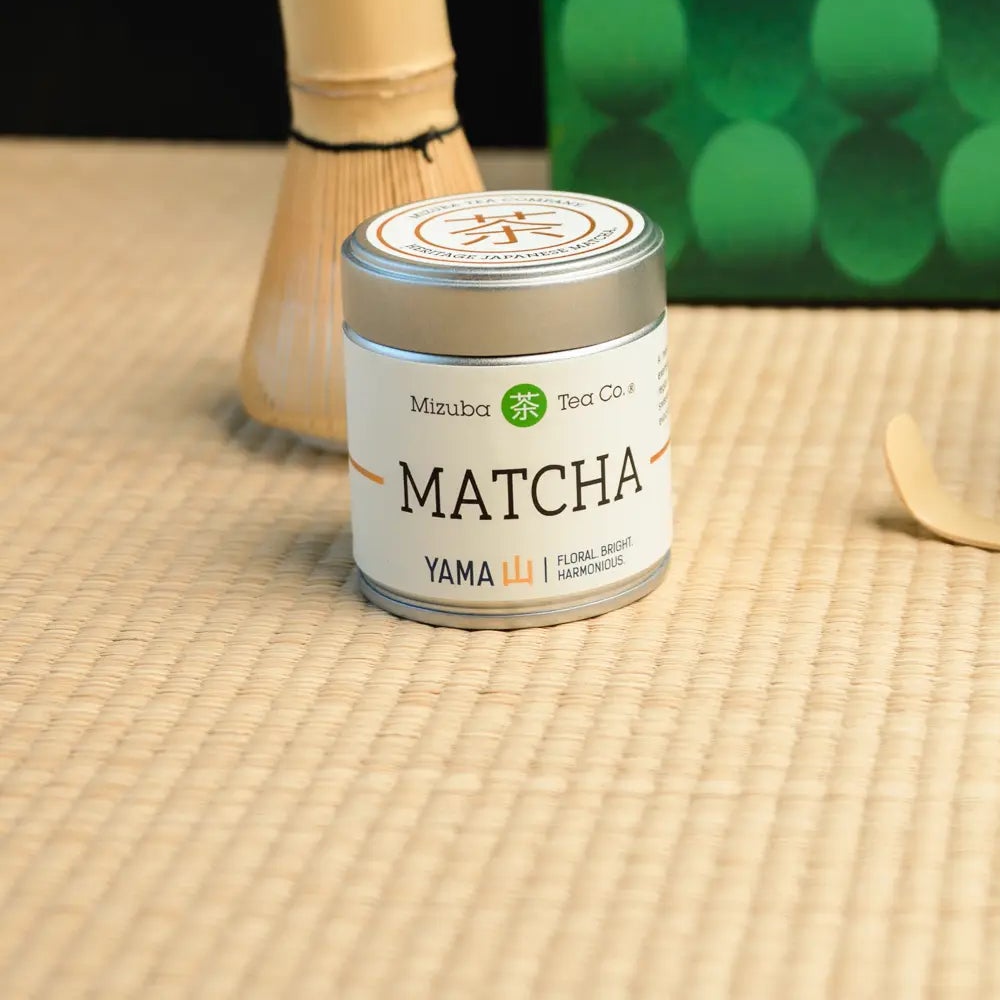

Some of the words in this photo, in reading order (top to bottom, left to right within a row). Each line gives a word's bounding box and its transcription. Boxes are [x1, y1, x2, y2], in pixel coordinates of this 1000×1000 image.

[444, 211, 565, 246] 茶
[404, 243, 476, 260] HERITAGE
[481, 247, 568, 260] JAPANESE
[410, 395, 491, 417] Mizuba
[510, 391, 540, 421] 茶
[557, 393, 594, 411] Tea
[399, 446, 643, 521] MATCHA
[424, 555, 495, 587] YAMA
[502, 554, 534, 587] 山
